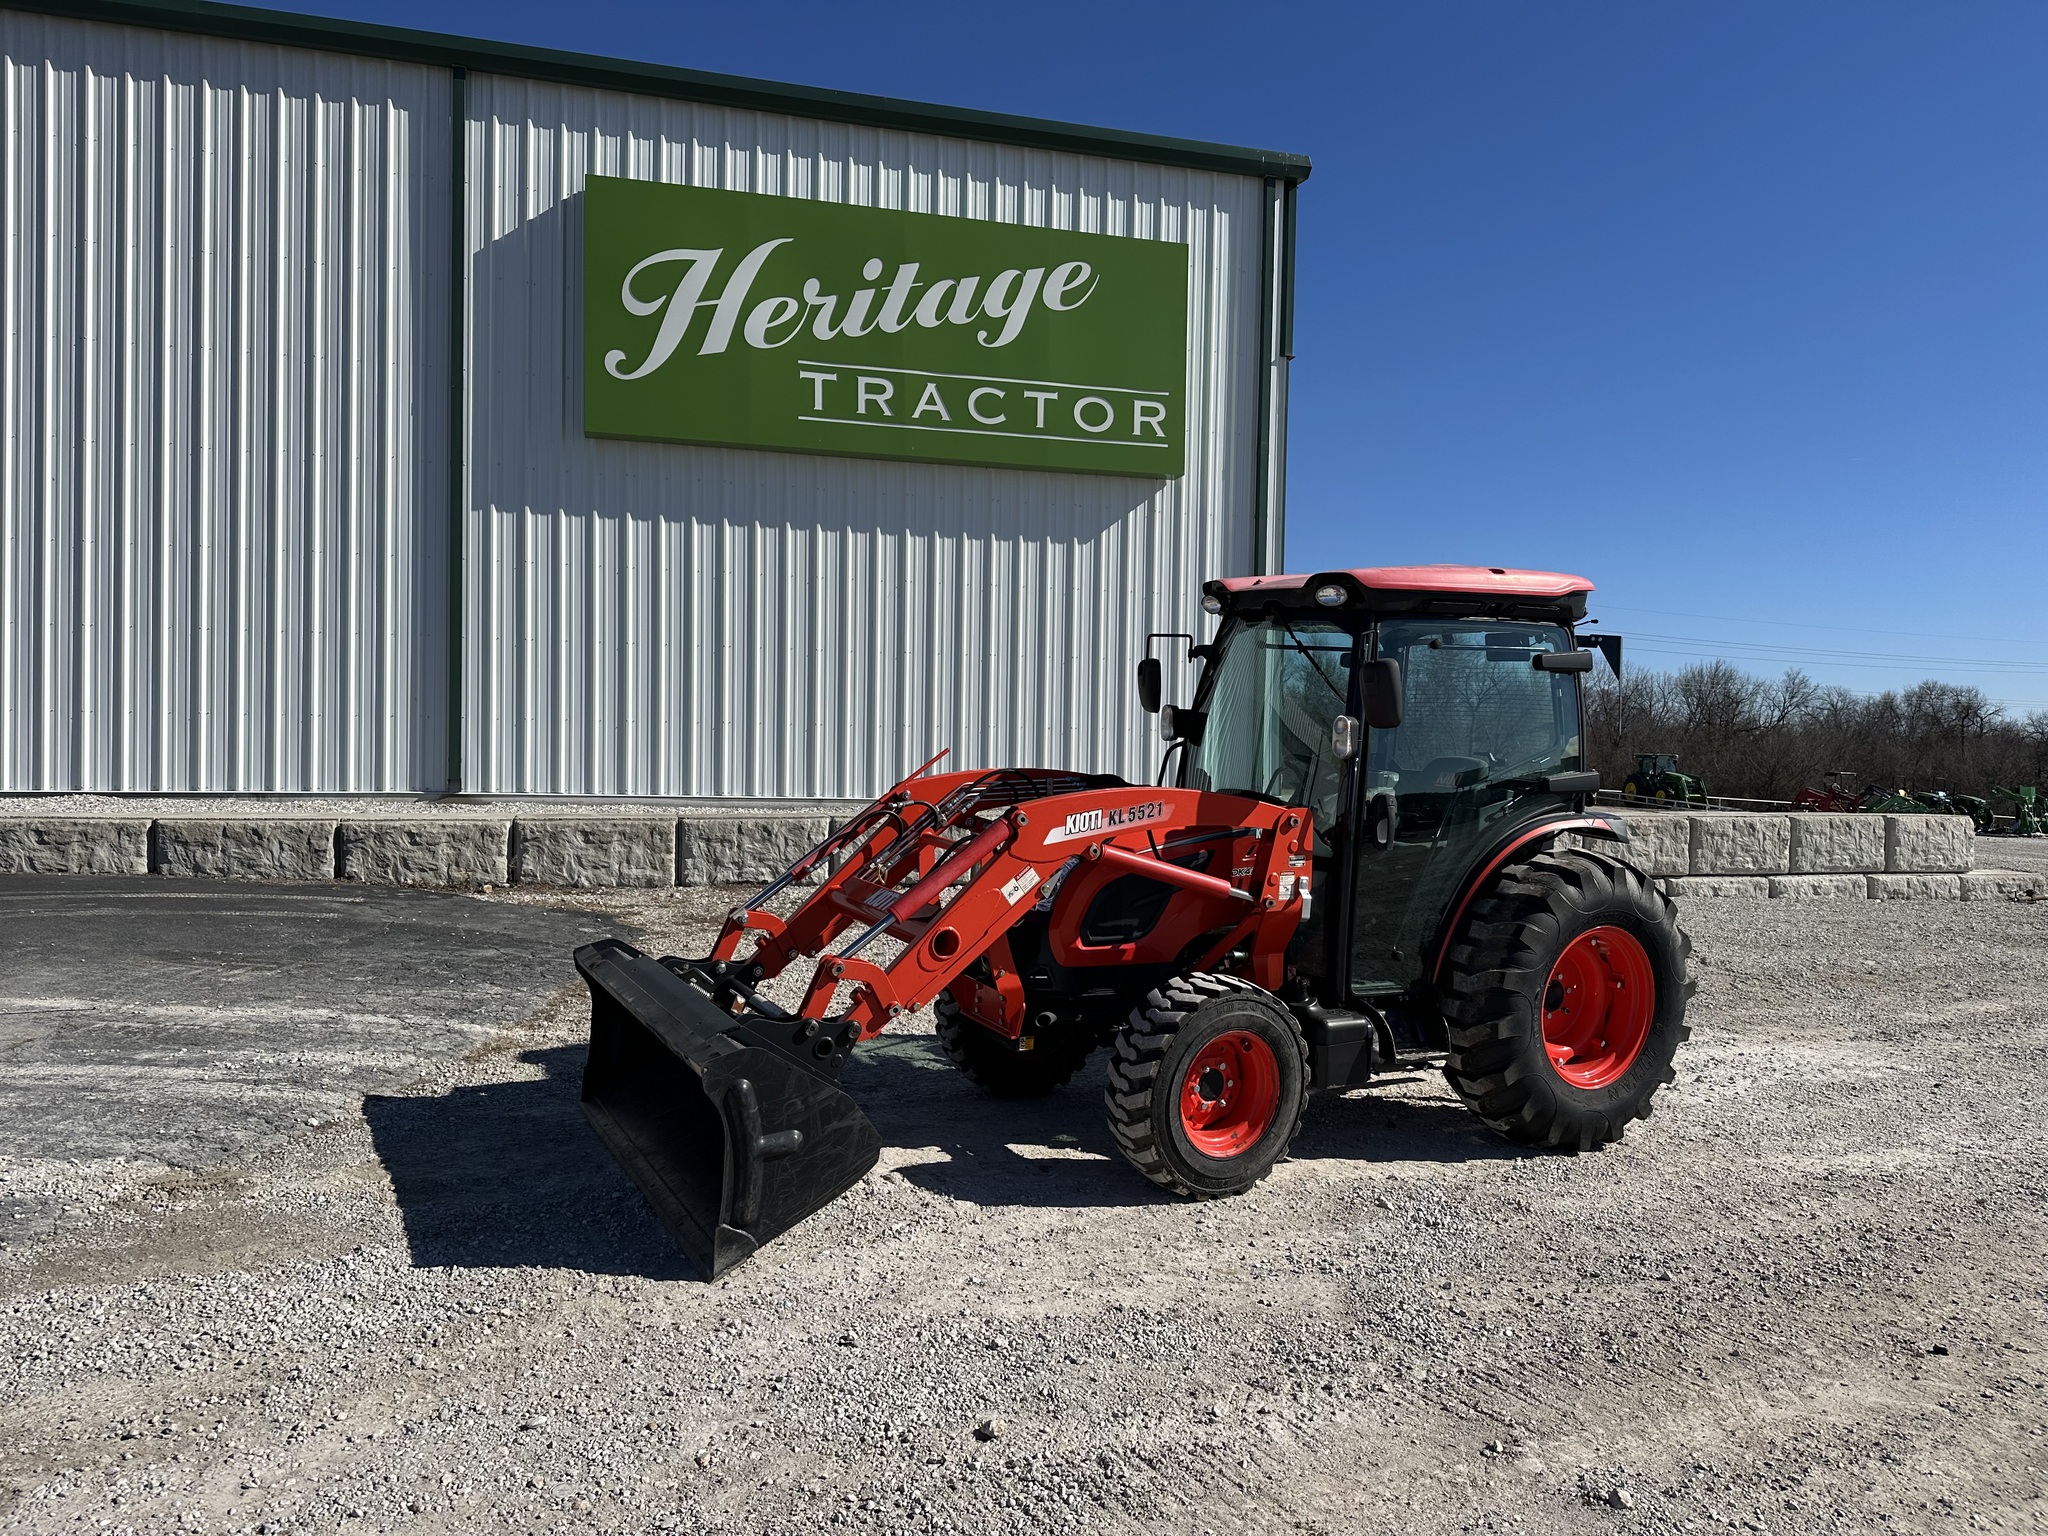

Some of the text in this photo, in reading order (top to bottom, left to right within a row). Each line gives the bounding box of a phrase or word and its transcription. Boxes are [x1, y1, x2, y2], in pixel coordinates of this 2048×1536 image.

[604, 237, 1100, 381] Heritage
[799, 369, 1168, 438] TRACTOR
[1064, 808, 1103, 836] KIOTI
